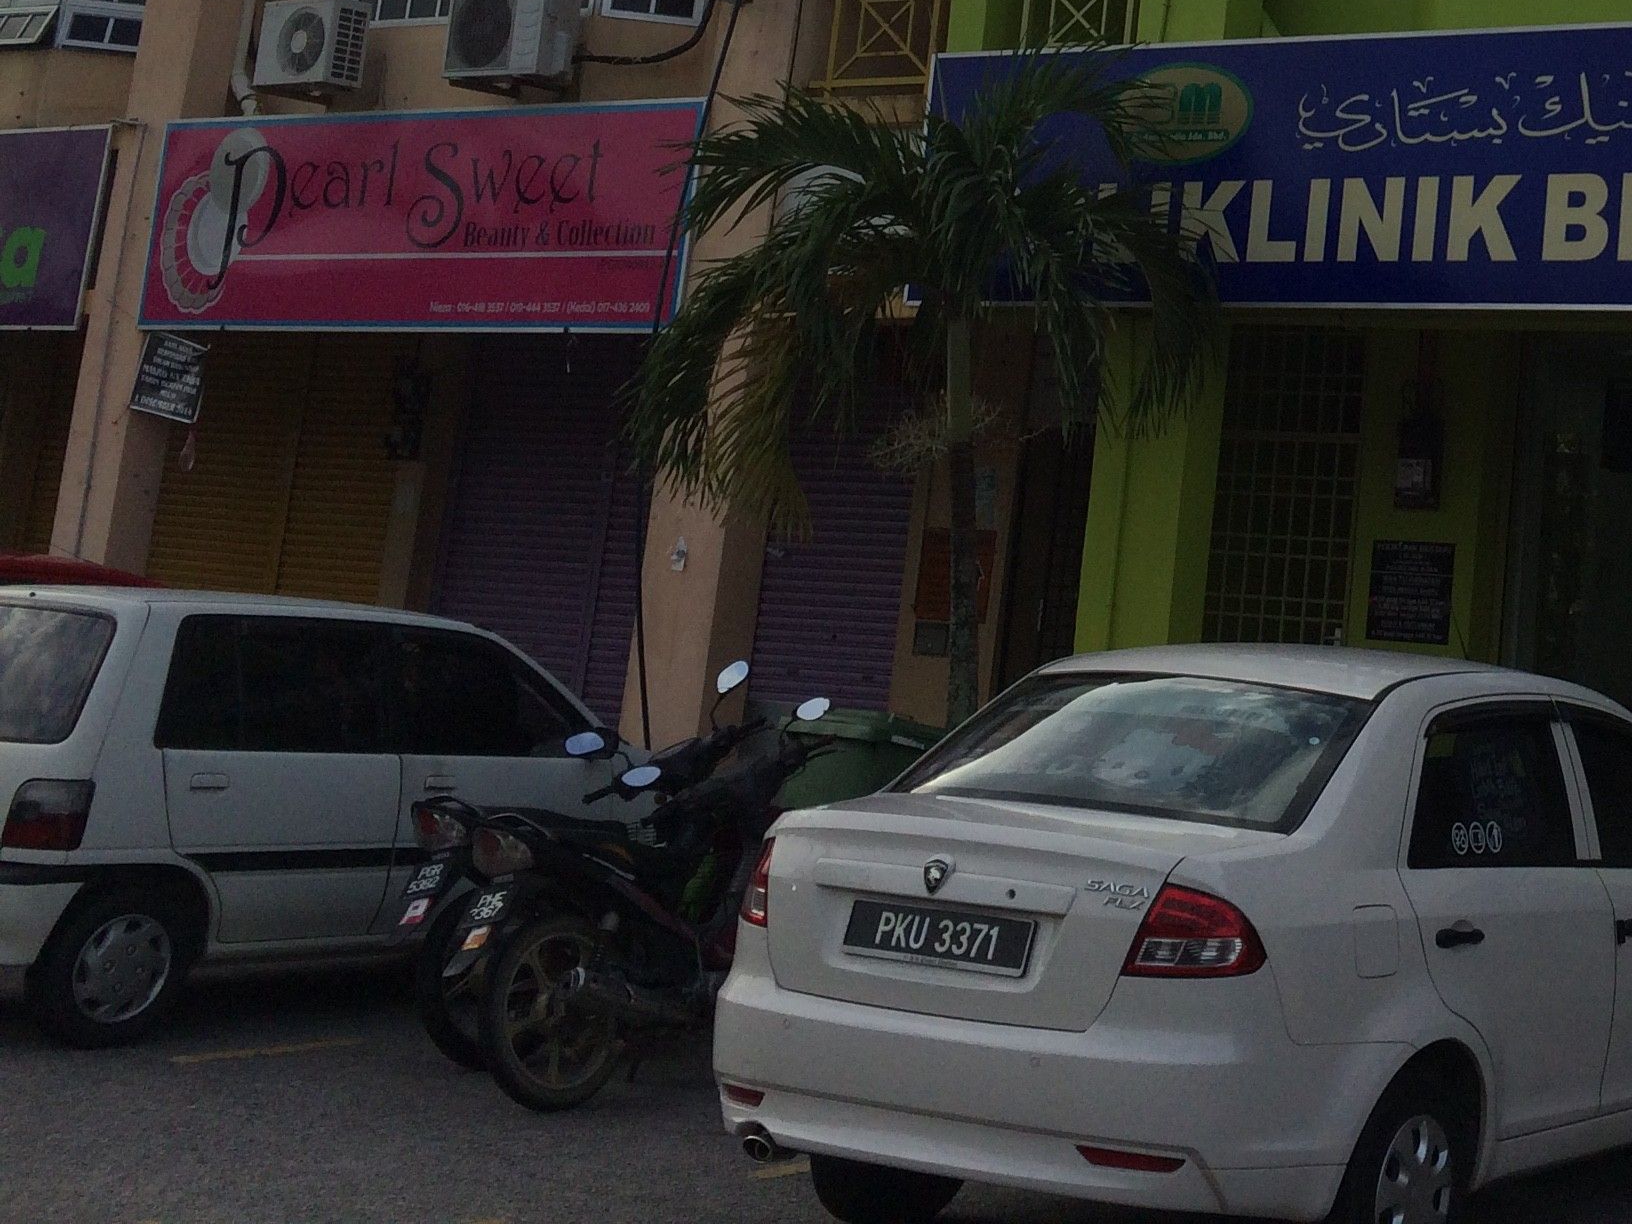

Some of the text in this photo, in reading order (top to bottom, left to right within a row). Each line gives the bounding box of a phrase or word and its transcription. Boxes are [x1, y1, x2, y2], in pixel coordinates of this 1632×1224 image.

[208, 138, 603, 290] Pearl Sweet
[464, 220, 655, 249] Beauty & Collection
[1084, 878, 1150, 899] SAGA
[1103, 896, 1147, 912] FLX
[874, 911, 999, 961] PKU 3371
